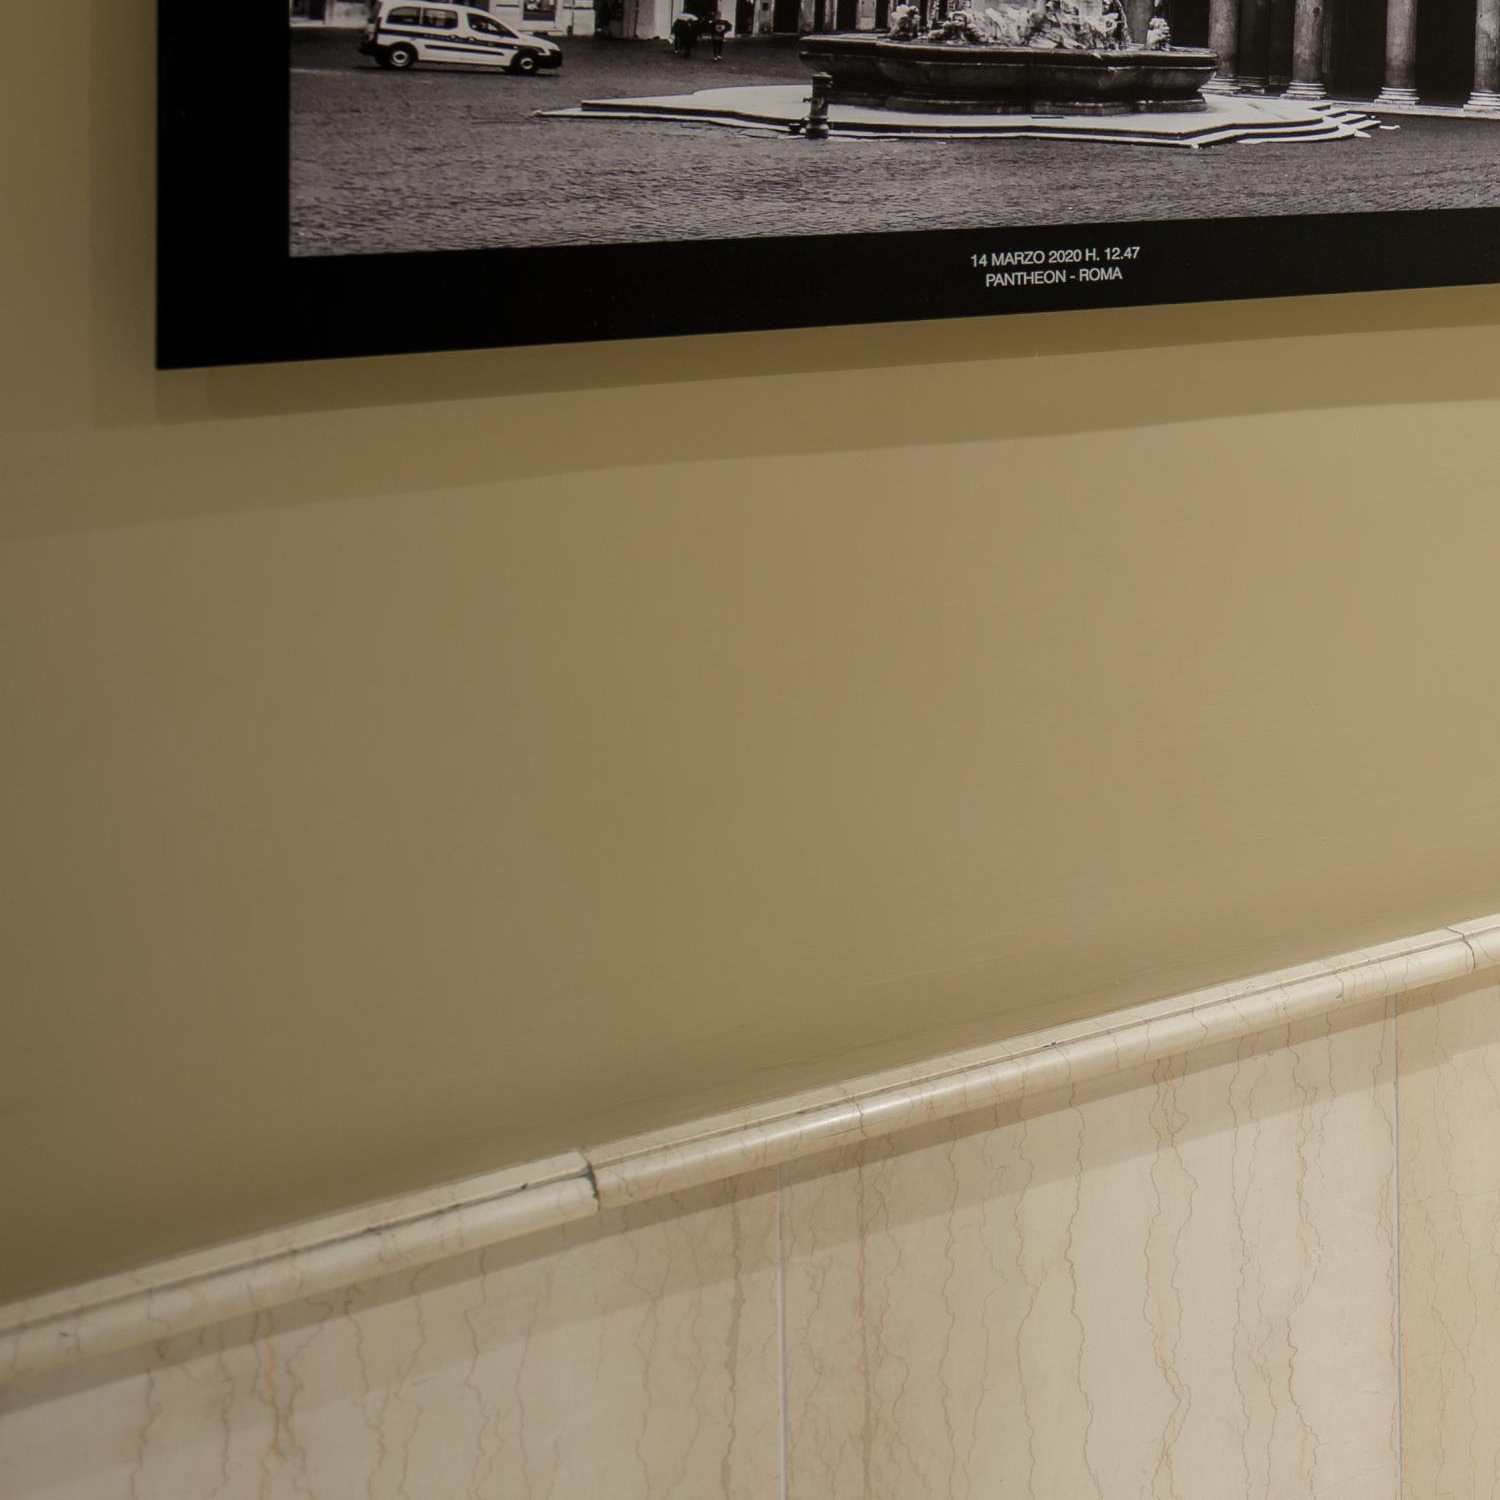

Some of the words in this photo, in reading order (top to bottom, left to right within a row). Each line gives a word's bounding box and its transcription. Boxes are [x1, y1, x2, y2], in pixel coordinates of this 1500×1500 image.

[970, 253, 988, 267] 14
[991, 250, 1045, 266] MARZO
[1048, 249, 1082, 264] 2020
[1085, 248, 1100, 261] H.
[1104, 246, 1141, 260] 12.47
[985, 269, 1067, 287] PANTHEON
[1079, 266, 1123, 282] ROMA
